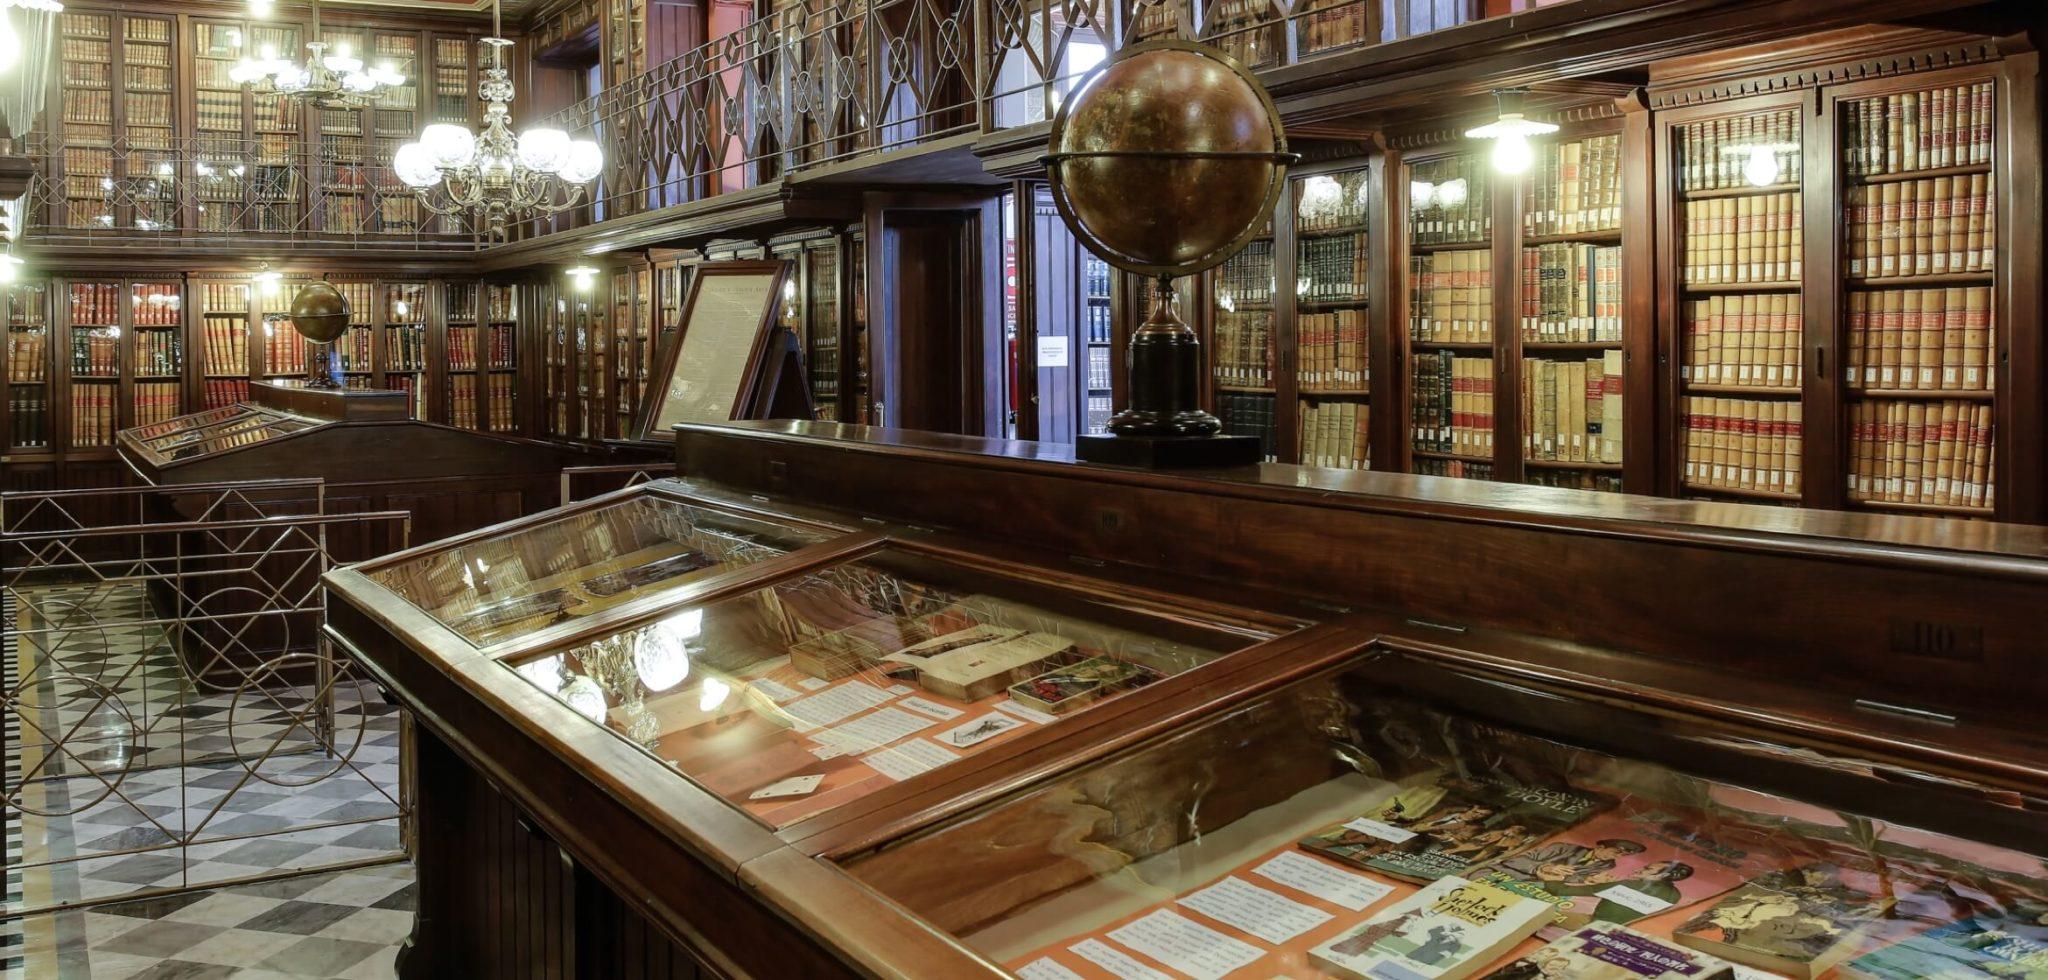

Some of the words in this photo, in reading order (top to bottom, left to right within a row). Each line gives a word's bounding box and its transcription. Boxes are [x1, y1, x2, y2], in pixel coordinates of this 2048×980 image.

[1506, 791, 1578, 814] DOYLE
[1438, 887, 1507, 916] Sherlock
[1514, 882, 1575, 911] ESTUDIO
[1426, 902, 1497, 924] Holmes
